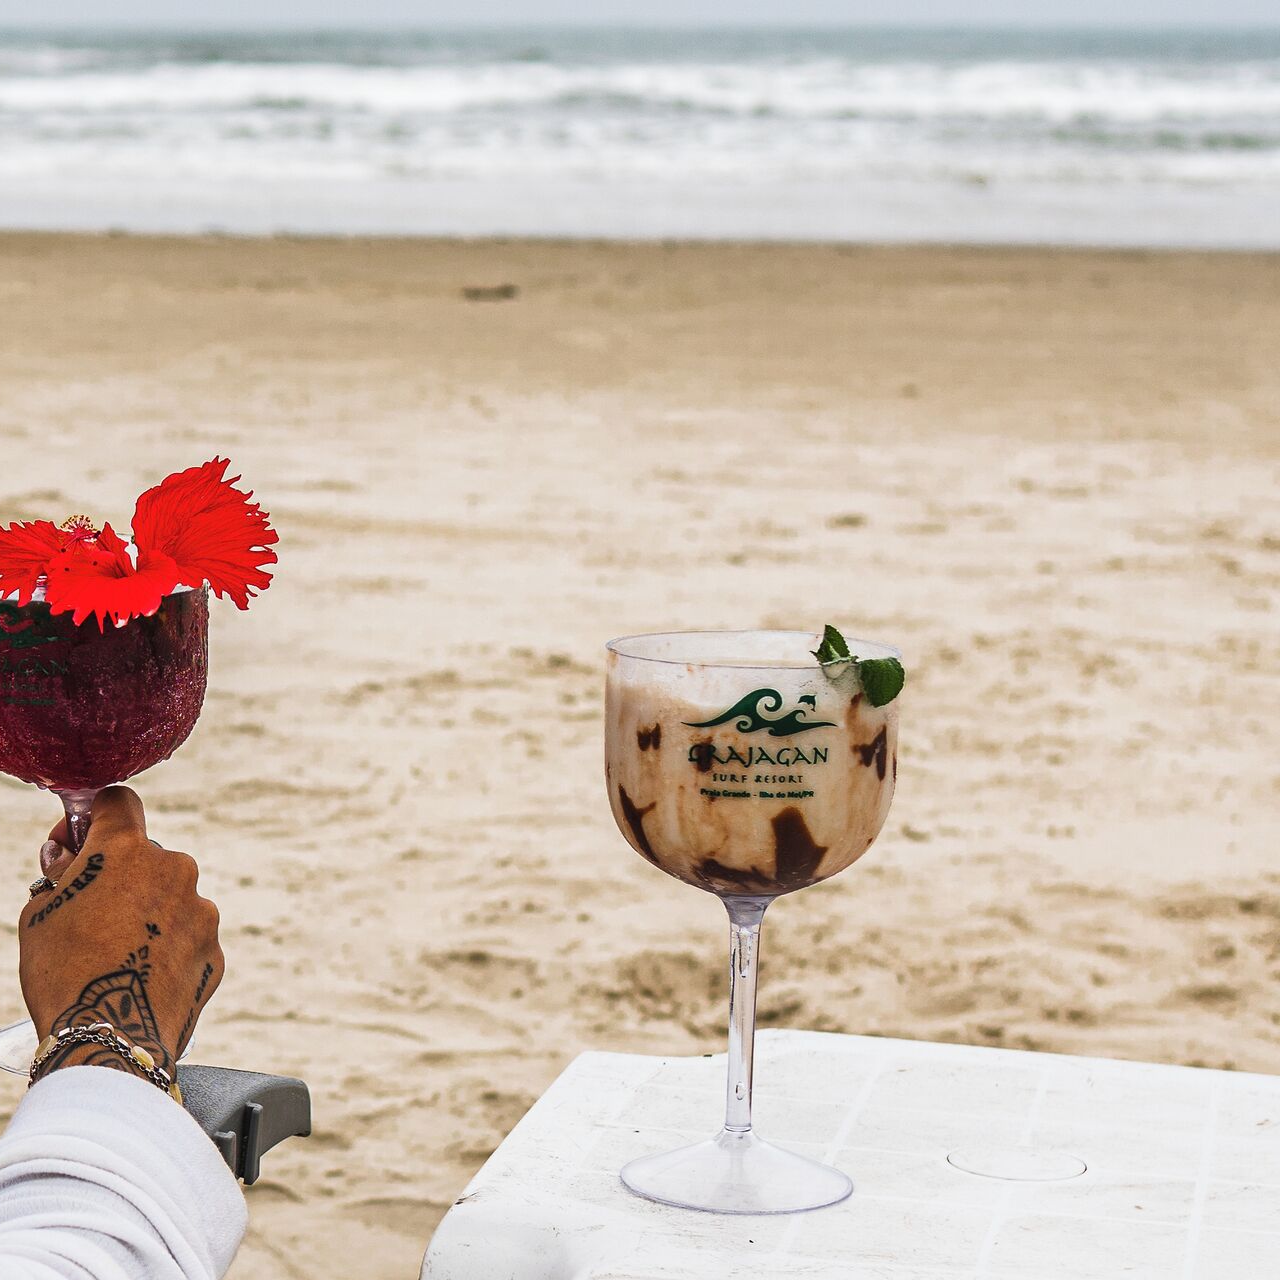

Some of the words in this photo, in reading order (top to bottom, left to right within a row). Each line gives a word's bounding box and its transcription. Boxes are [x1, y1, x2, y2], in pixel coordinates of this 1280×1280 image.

[712, 773, 748, 783] SURF
[754, 774, 804, 784] RESORT
[722, 790, 751, 798] Grande
